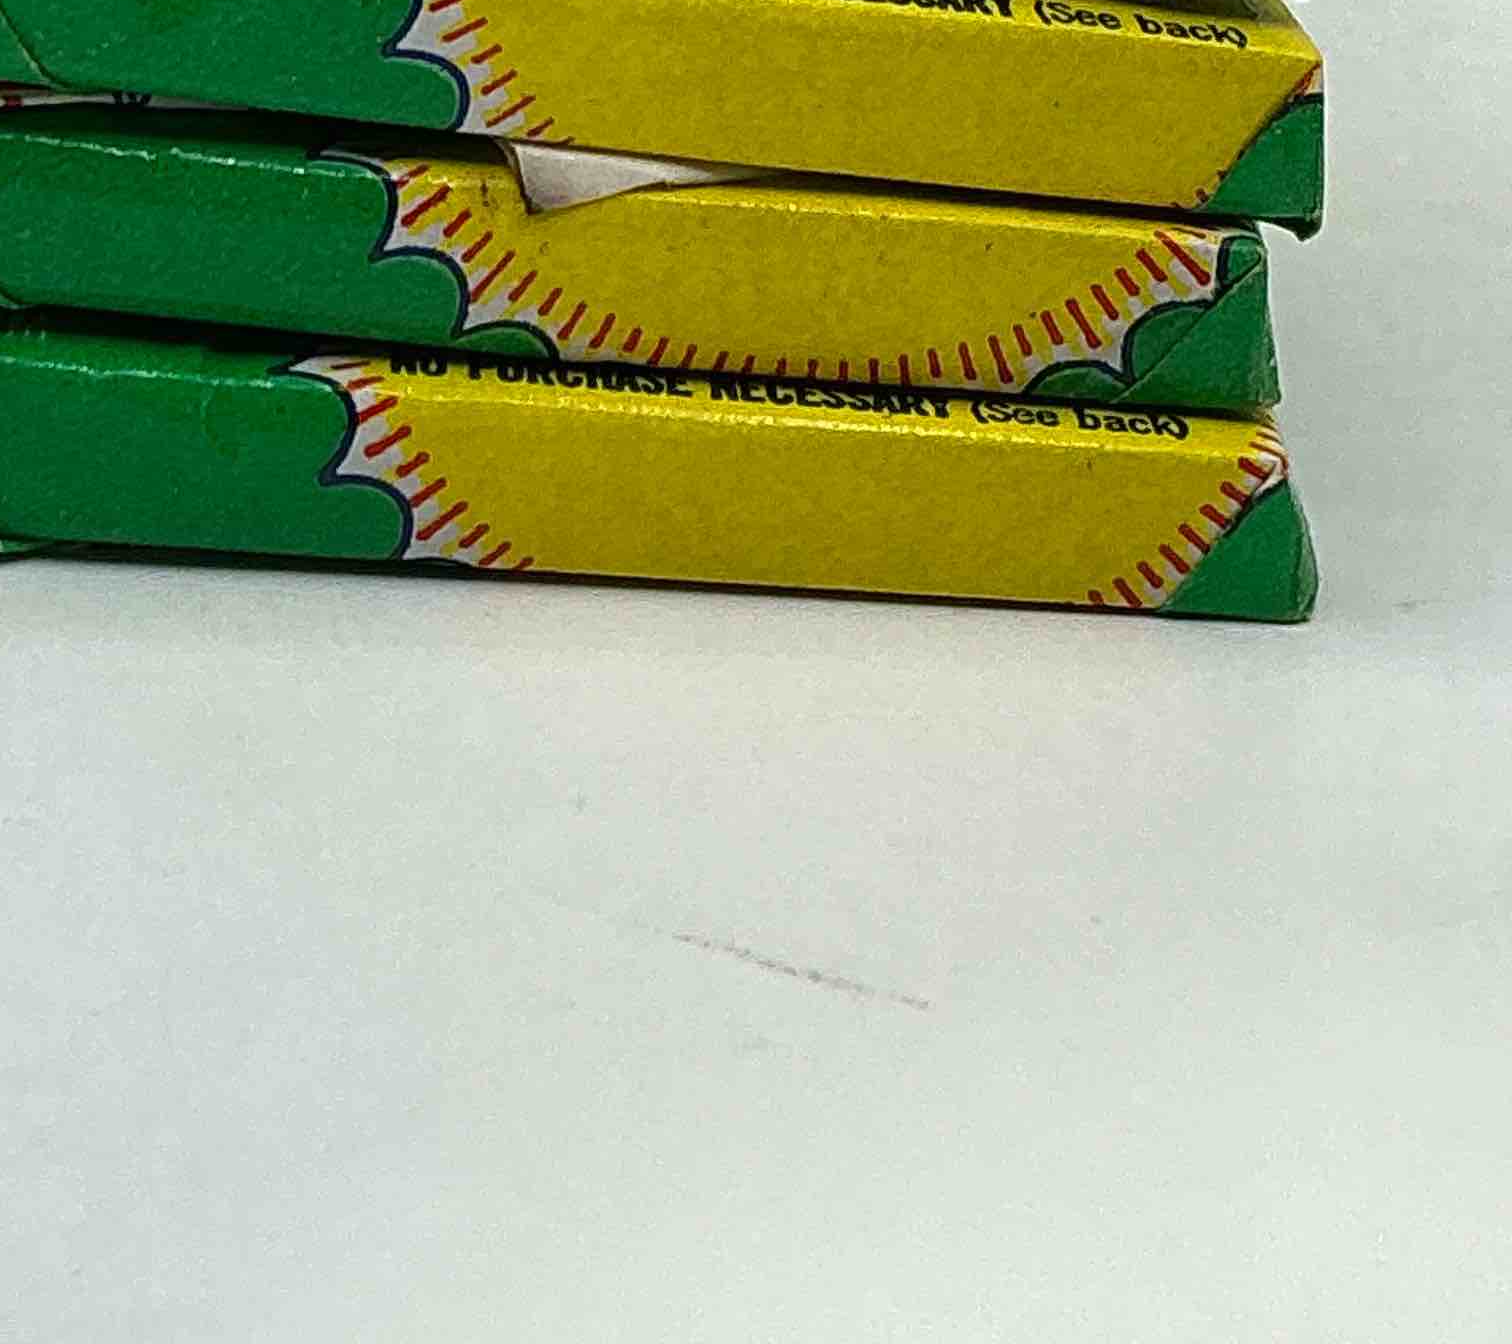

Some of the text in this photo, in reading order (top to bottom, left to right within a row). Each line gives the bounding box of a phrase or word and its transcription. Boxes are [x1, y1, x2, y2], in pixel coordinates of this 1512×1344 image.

[1133, 13, 1249, 49] back)
[971, 398, 1061, 428] (See
[1075, 403, 1190, 440] back)
